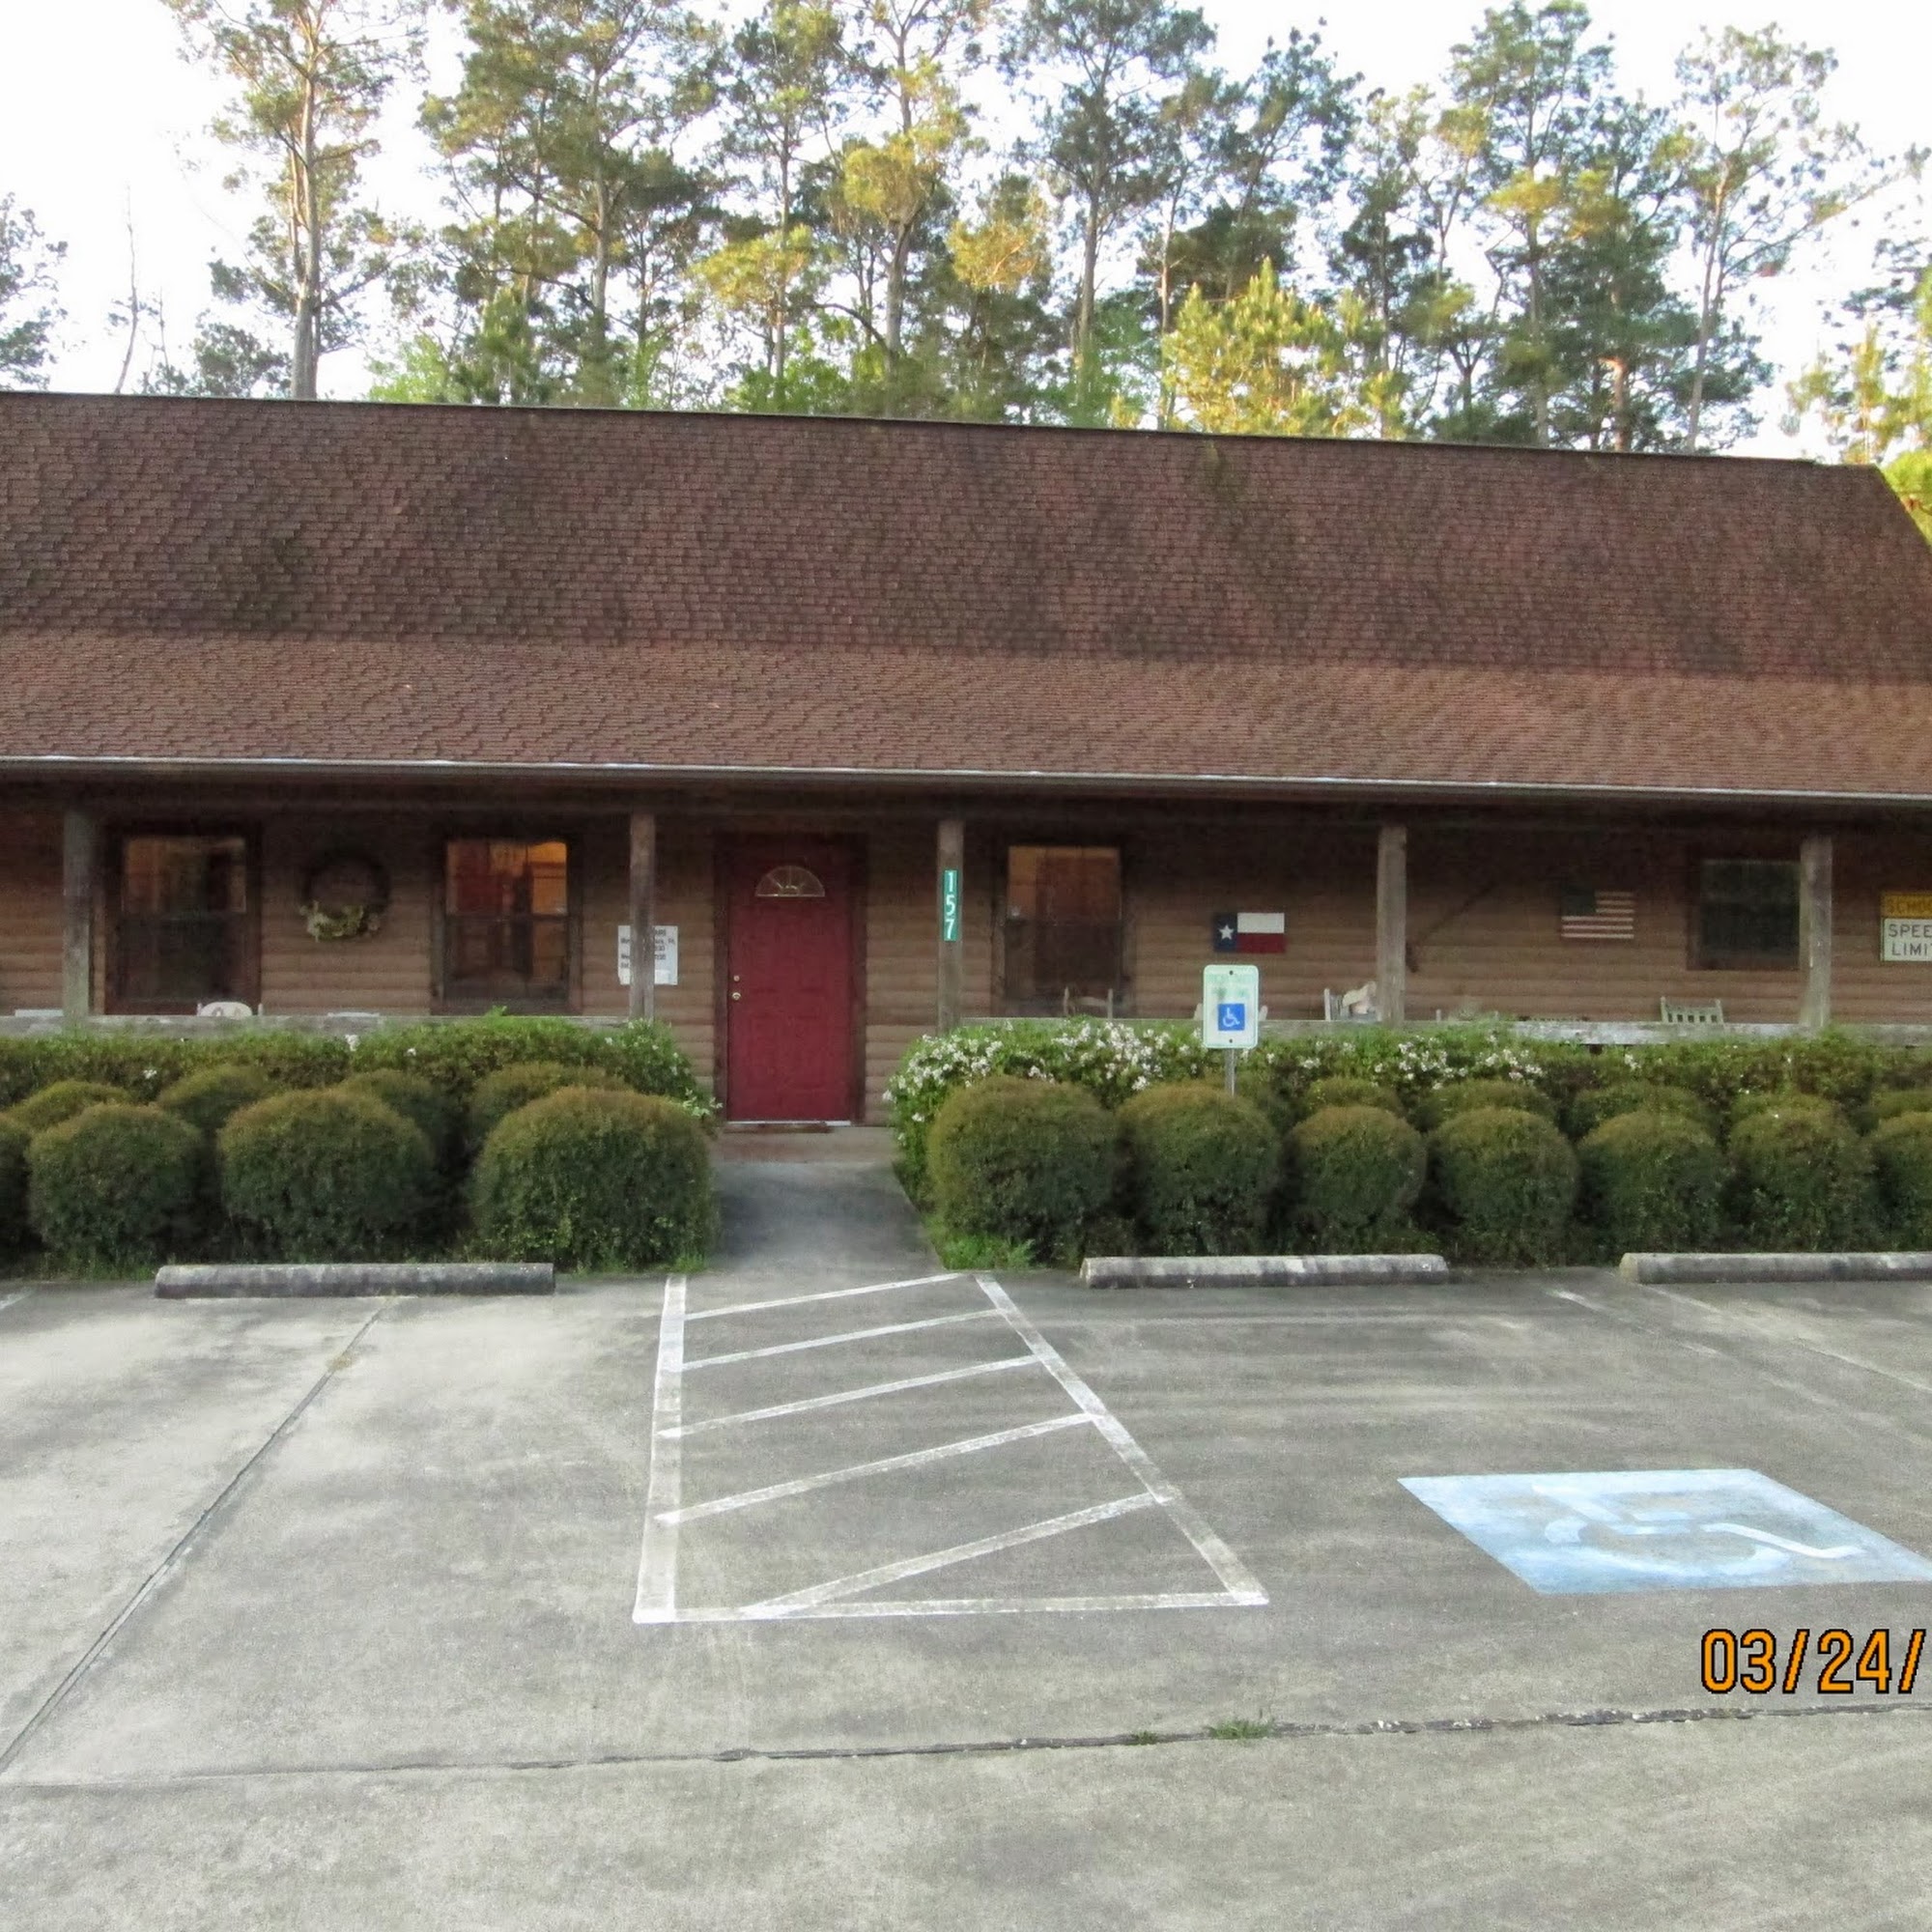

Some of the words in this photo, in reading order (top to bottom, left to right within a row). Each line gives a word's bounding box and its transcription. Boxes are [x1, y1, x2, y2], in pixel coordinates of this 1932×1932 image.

[946, 871, 955, 939] 157
[1888, 923, 1932, 938] SPEE
[1891, 943, 1932, 956] LIMI
